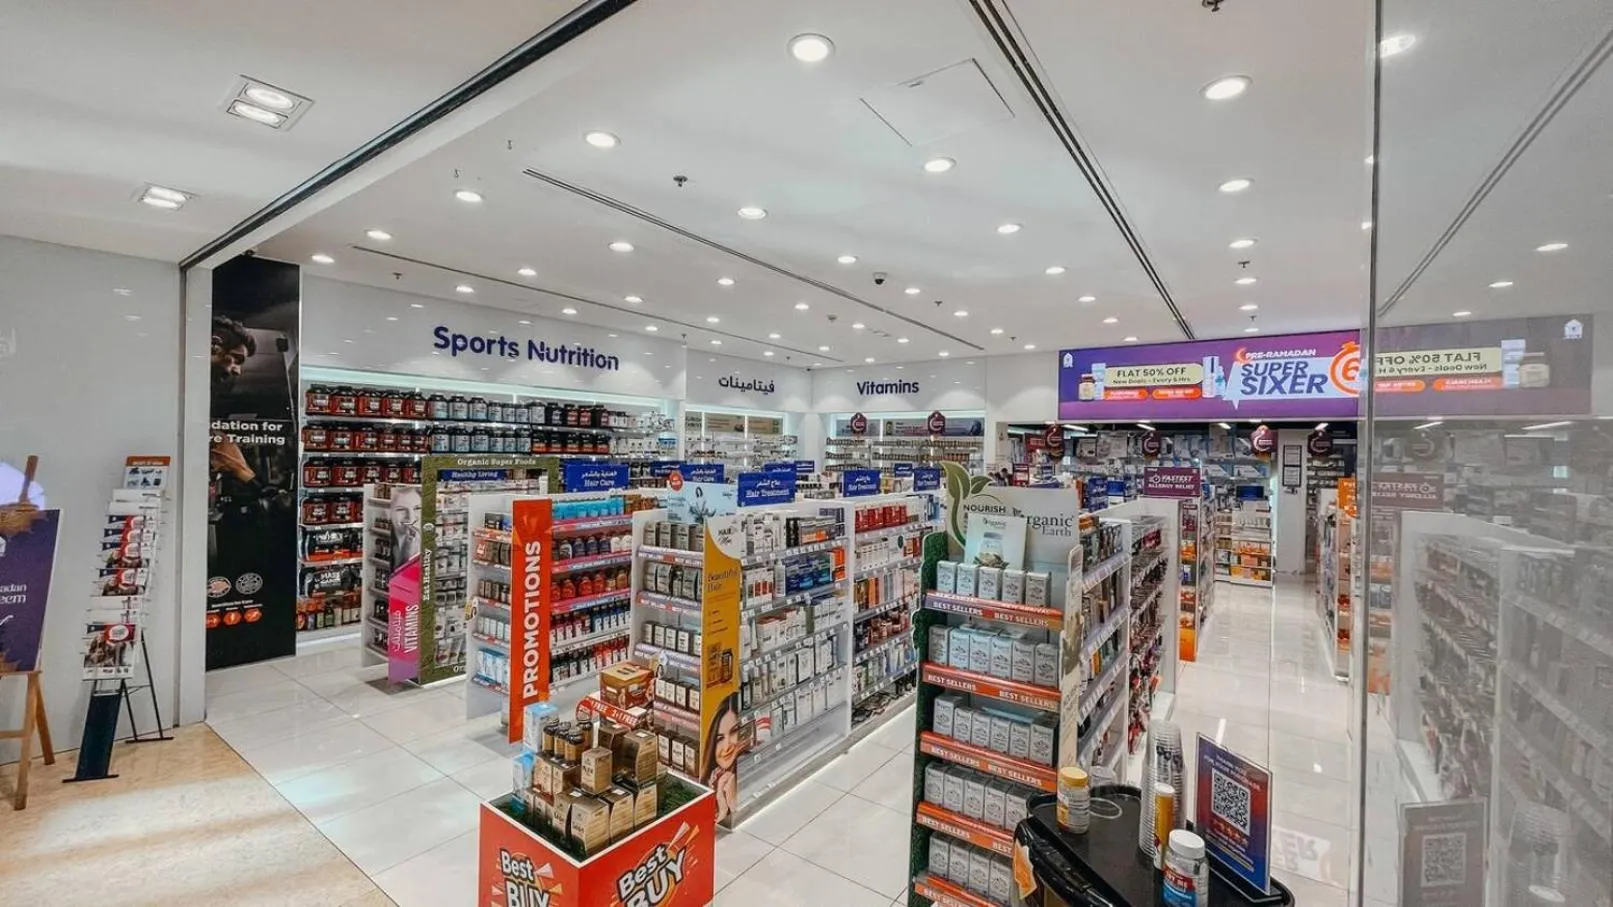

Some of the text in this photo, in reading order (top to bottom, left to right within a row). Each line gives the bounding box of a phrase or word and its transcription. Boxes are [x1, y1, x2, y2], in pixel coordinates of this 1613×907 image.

[434, 326, 620, 371] Sports Nutrition
[1245, 348, 1316, 359] PRE-RAMADAN
[1117, 367, 1187, 378] FLAT 50% OFF
[1241, 361, 1309, 378] SUPER
[718, 376, 775, 396] فيتامينات
[857, 379, 919, 396] Vitamins
[1241, 373, 1328, 396] SIXER
[211, 420, 283, 431] dation for
[226, 434, 286, 446] Training
[457, 458, 489, 467] Organic
[584, 479, 599, 487] Hair
[963, 504, 1006, 513] NOURISH
[1042, 526, 1072, 537] Earth
[523, 540, 541, 699] PROMOTIONS
[933, 602, 953, 611] BEST
[953, 604, 983, 616] SELLERS
[994, 612, 1013, 621] BEST
[404, 604, 419, 653] VITAMINS
[928, 674, 945, 684] BEST
[946, 678, 976, 691] SELLERS
[999, 690, 1018, 700] BEST
[931, 746, 950, 758] BEST
[922, 816, 940, 827] BEST
[941, 822, 970, 840] SELLERS
[500, 848, 536, 882] Best
[617, 843, 668, 900] Best
[626, 847, 687, 907] BUY
[504, 877, 550, 907] BUY
